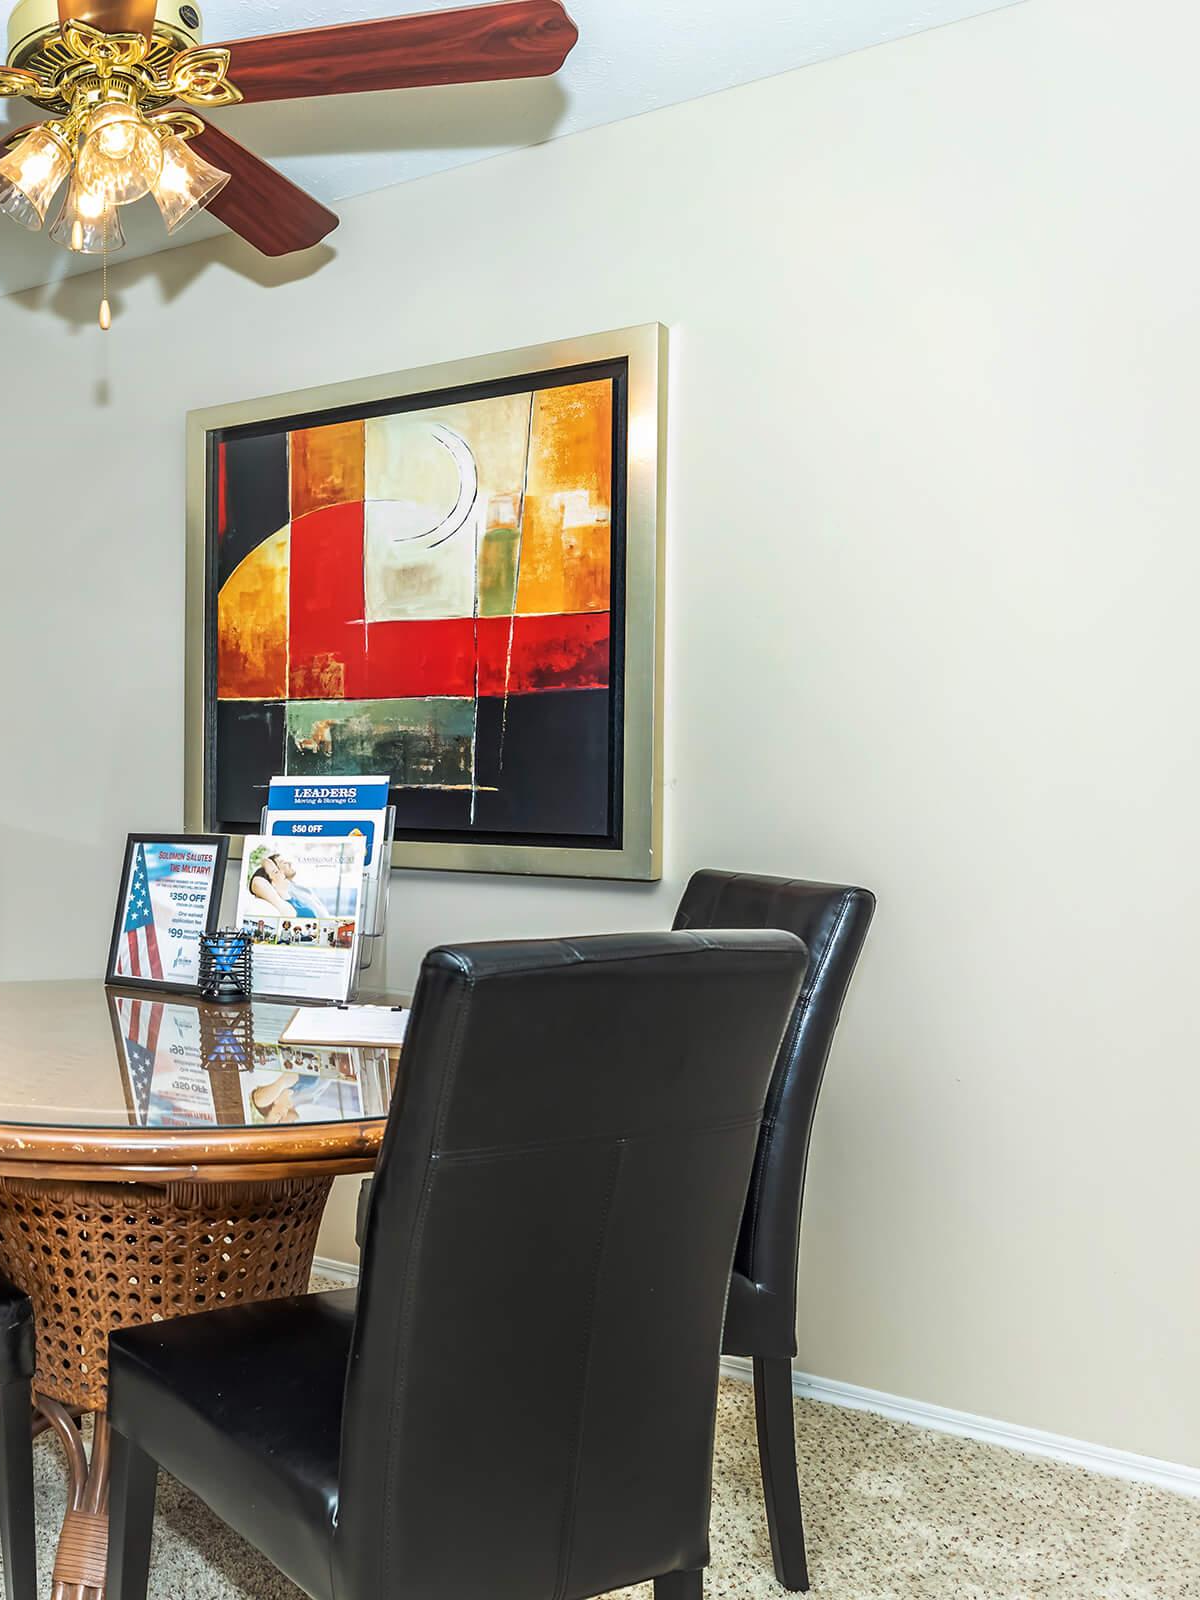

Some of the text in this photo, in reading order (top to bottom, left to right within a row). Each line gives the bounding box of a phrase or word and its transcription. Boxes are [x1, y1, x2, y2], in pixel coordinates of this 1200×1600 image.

[294, 788, 357, 798] LEADERS
[292, 825, 323, 833] $50 OFF
[186, 852, 213, 862] SALUTES
[170, 892, 207, 902] $350 OFF
[168, 928, 183, 939] $99
